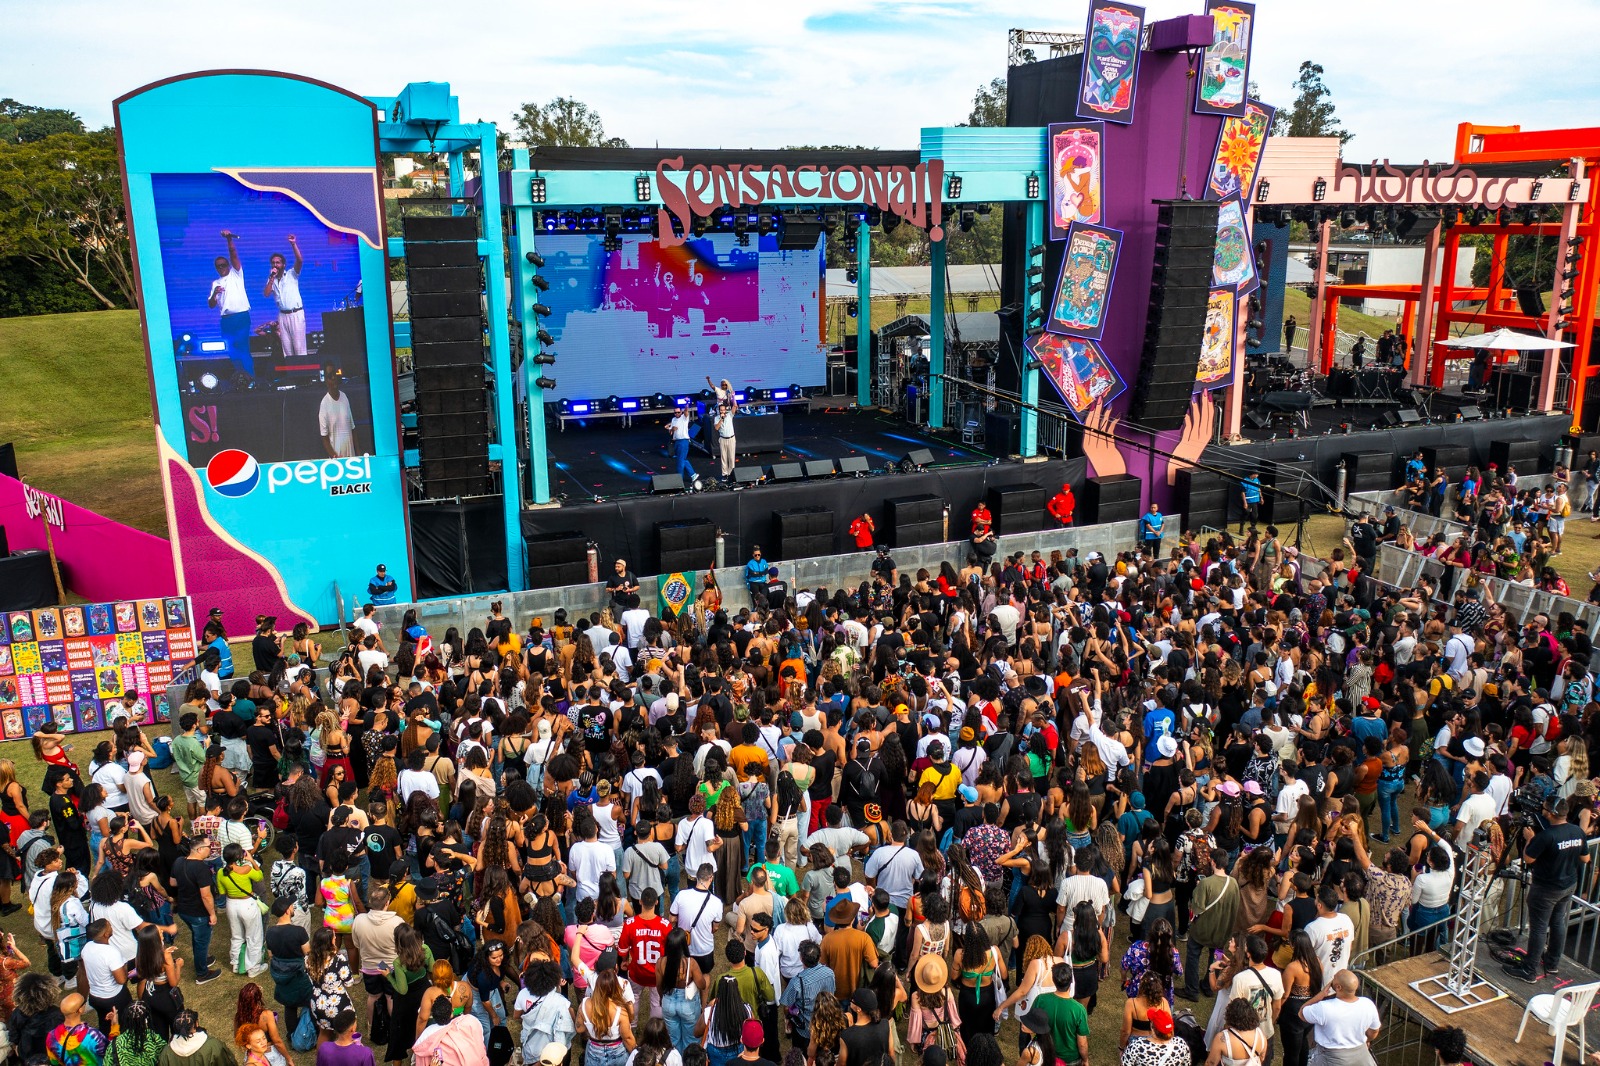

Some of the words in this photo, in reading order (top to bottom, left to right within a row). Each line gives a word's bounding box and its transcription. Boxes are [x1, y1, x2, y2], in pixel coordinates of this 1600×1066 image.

[189, 405, 219, 444] S!
[268, 453, 371, 493] pepsi
[330, 482, 372, 497] BLACK
[637, 940, 660, 965] 16
